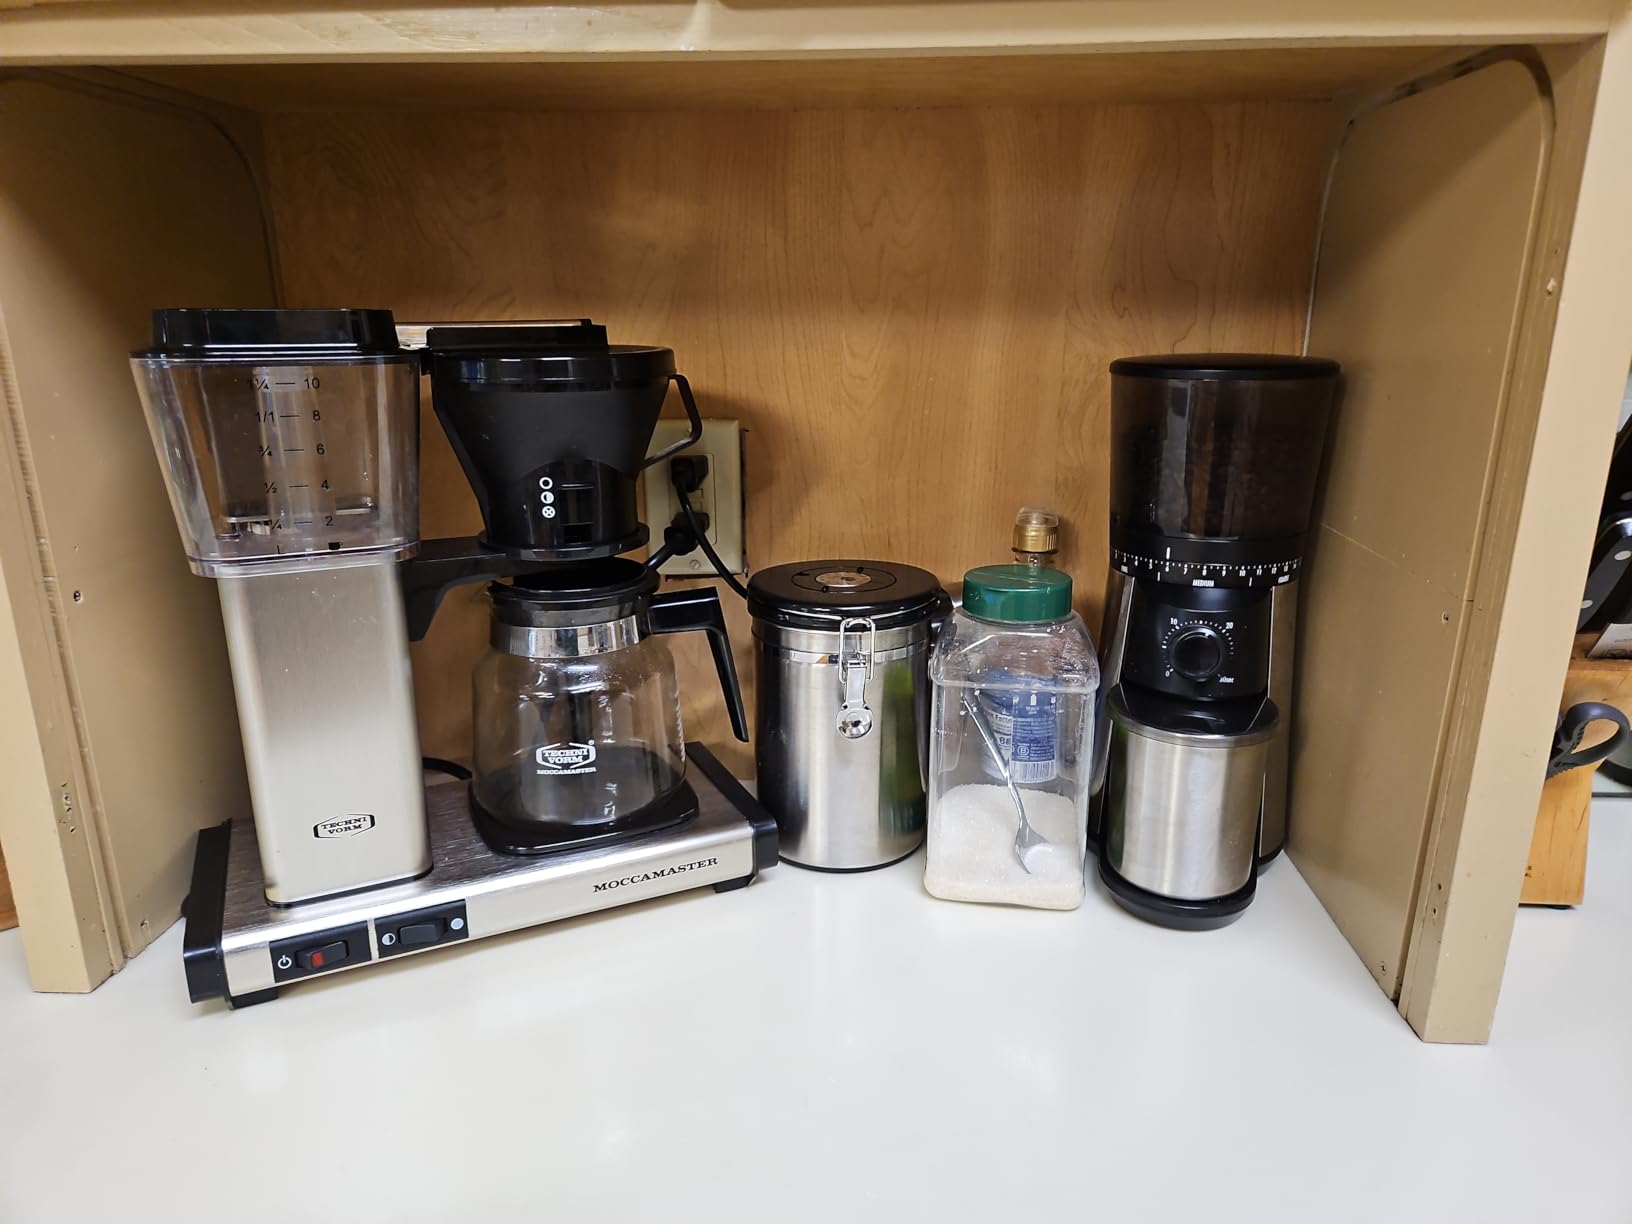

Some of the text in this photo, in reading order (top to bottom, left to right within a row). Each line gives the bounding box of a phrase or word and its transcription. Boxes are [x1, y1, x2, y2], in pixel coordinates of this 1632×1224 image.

[303, 376, 321, 390] 10
[255, 409, 321, 423] 1/1 8
[316, 443, 326, 456] 6
[321, 479, 329, 490] 4
[325, 515, 334, 527] 2
[1239, 569, 1247, 577] 10
[1256, 568, 1263, 577] 11
[1170, 617, 1178, 626] 10
[1225, 621, 1234, 630] 20
[543, 748, 588, 757] TECHNI
[547, 755, 583, 763] VORM
[536, 767, 597, 775] MOCCAMASTER
[320, 816, 368, 830] TECHNI
[327, 823, 363, 834] VORM
[592, 857, 719, 893] MOCCAMASTER
